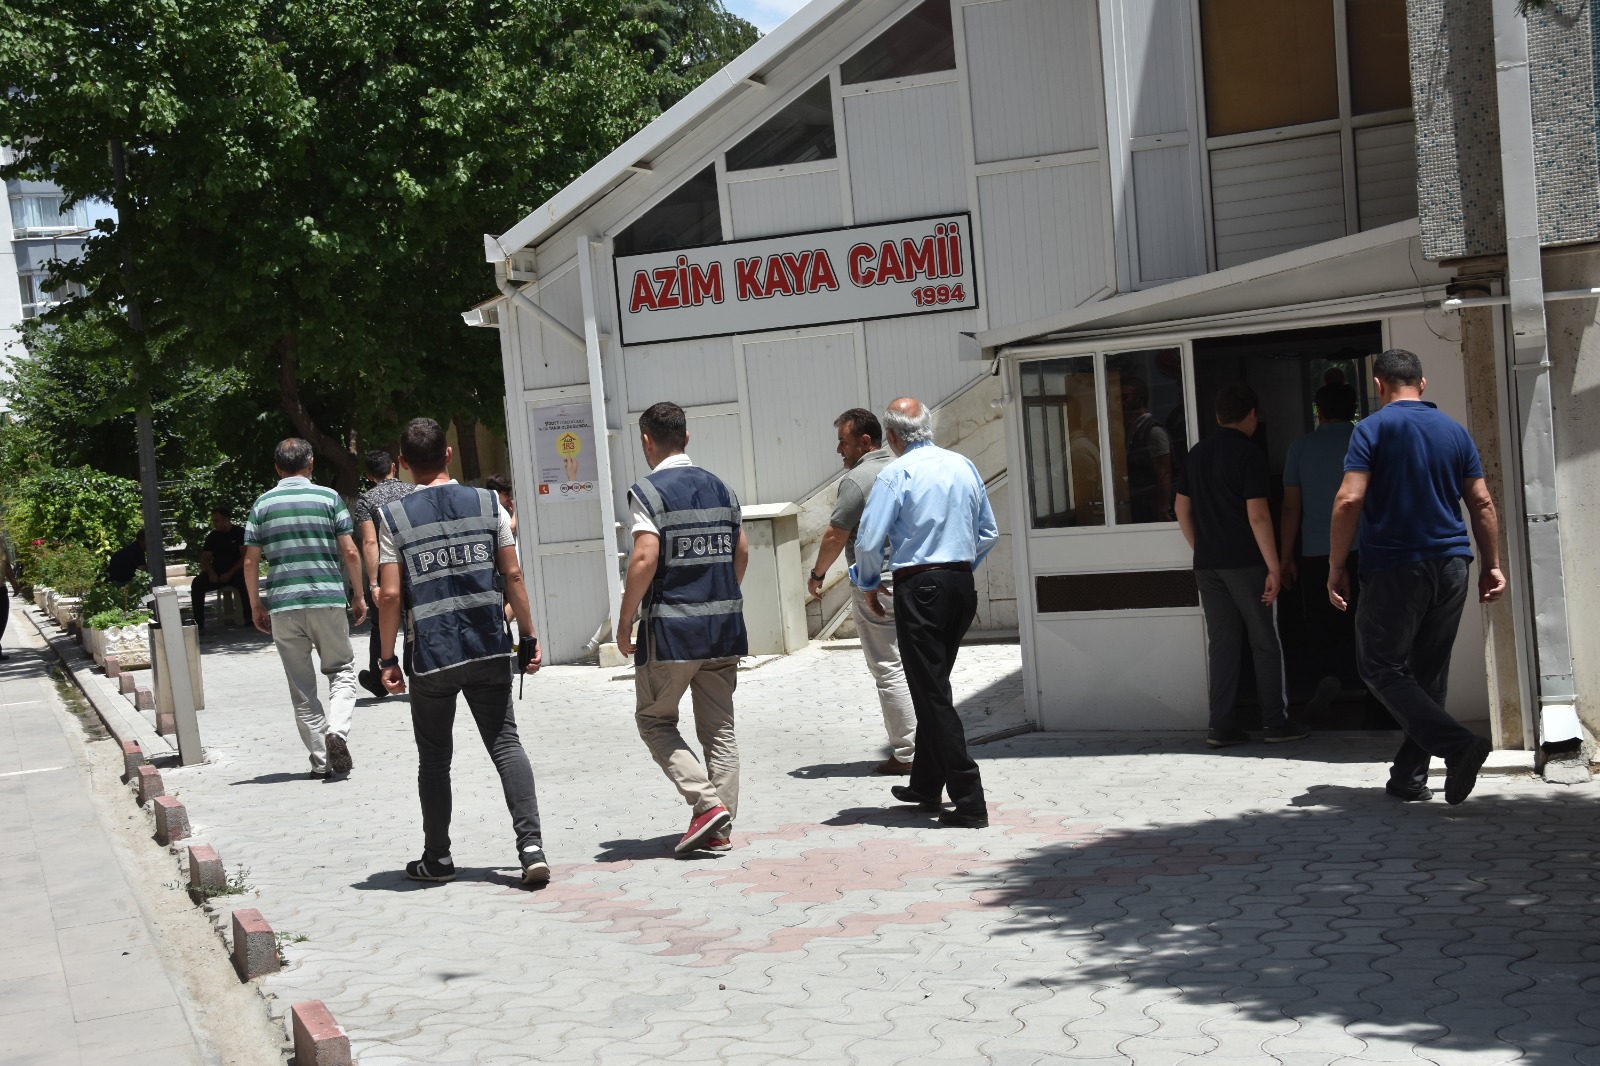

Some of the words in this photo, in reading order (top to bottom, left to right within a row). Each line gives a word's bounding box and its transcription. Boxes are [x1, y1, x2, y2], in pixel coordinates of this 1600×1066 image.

[629, 254, 724, 313] AZİM
[735, 249, 839, 301] KAYA
[848, 222, 963, 288] CAMİİ
[912, 283, 965, 307] 1994
[419, 543, 489, 572] POLİS
[678, 534, 732, 557] POLİS
